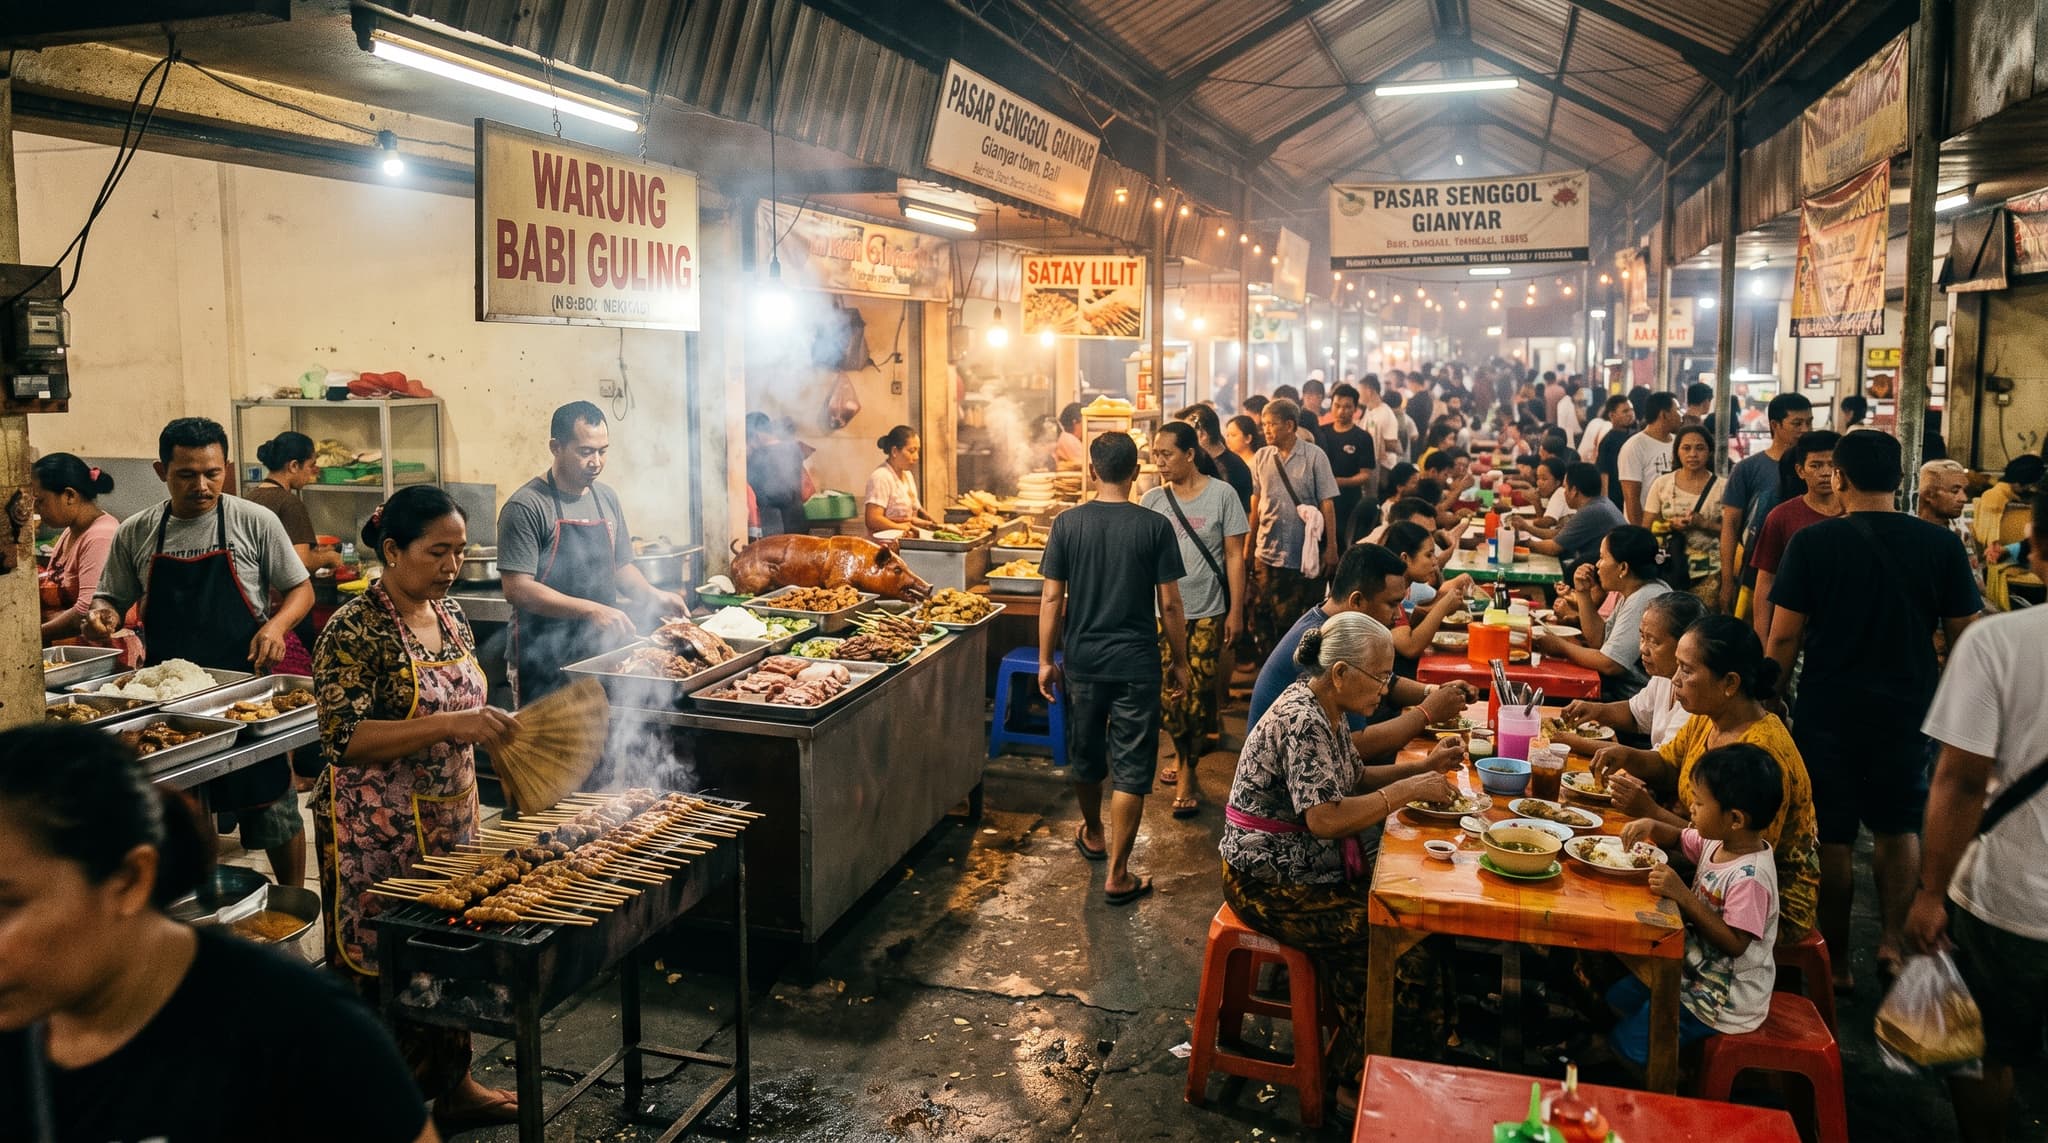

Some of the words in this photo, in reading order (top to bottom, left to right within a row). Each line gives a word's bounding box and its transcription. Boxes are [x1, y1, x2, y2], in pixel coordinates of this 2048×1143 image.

[946, 73, 995, 127] PASAR
[994, 98, 1050, 153] SENGGOL
[1051, 127, 1097, 171] GIANYAR
[981, 135, 1019, 167] Gianyar
[532, 149, 666, 229] WARUNG
[1373, 188, 1438, 210] PASAR
[1446, 182, 1542, 206] SENGGOL
[1412, 209, 1502, 232] GIANYAR
[497, 218, 576, 285] BABI
[587, 232, 692, 292] GULING
[1028, 261, 1085, 285] SATAY
[1091, 261, 1137, 286] LILIT
